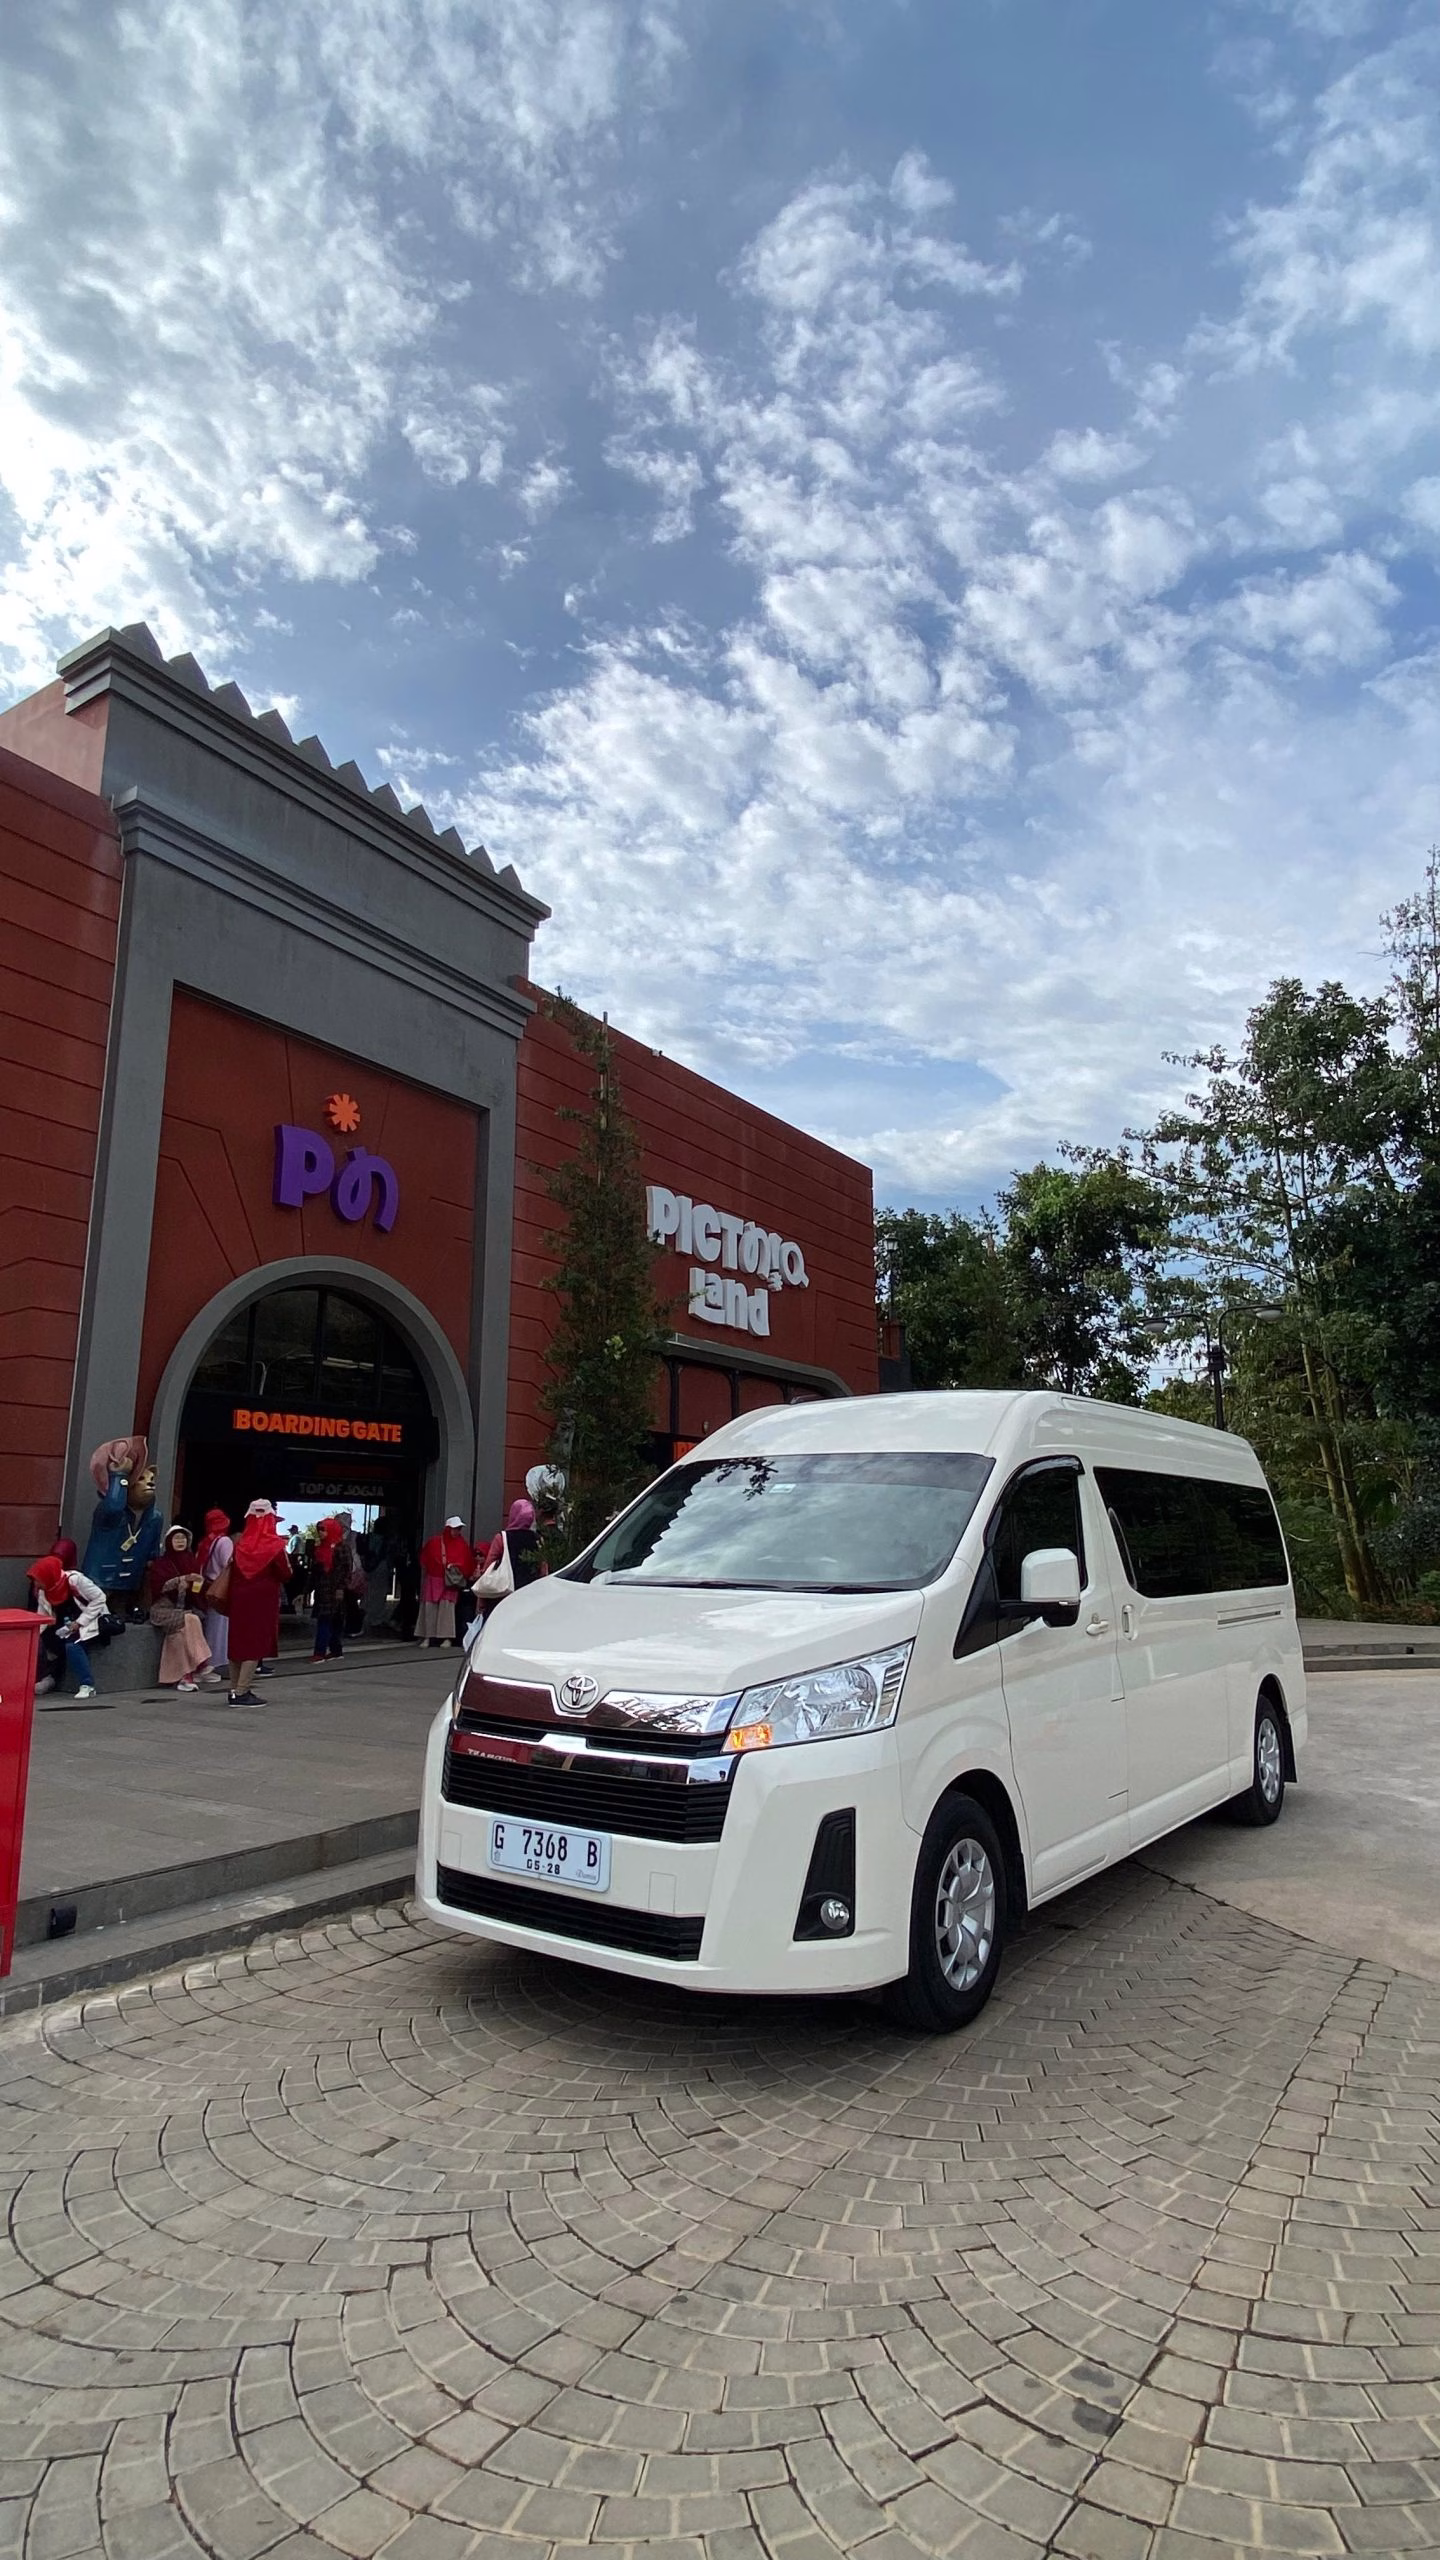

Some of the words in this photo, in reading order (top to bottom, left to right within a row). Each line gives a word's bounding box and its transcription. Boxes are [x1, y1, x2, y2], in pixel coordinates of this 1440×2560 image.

[234, 1409, 350, 1438] BOARDING
[352, 1421, 402, 1442] GATE
[299, 1482, 324, 1496] TOP
[326, 1483, 343, 1496] OF
[494, 1824, 505, 1849] G
[522, 1829, 568, 1861] 7368
[586, 1841, 598, 1867] B
